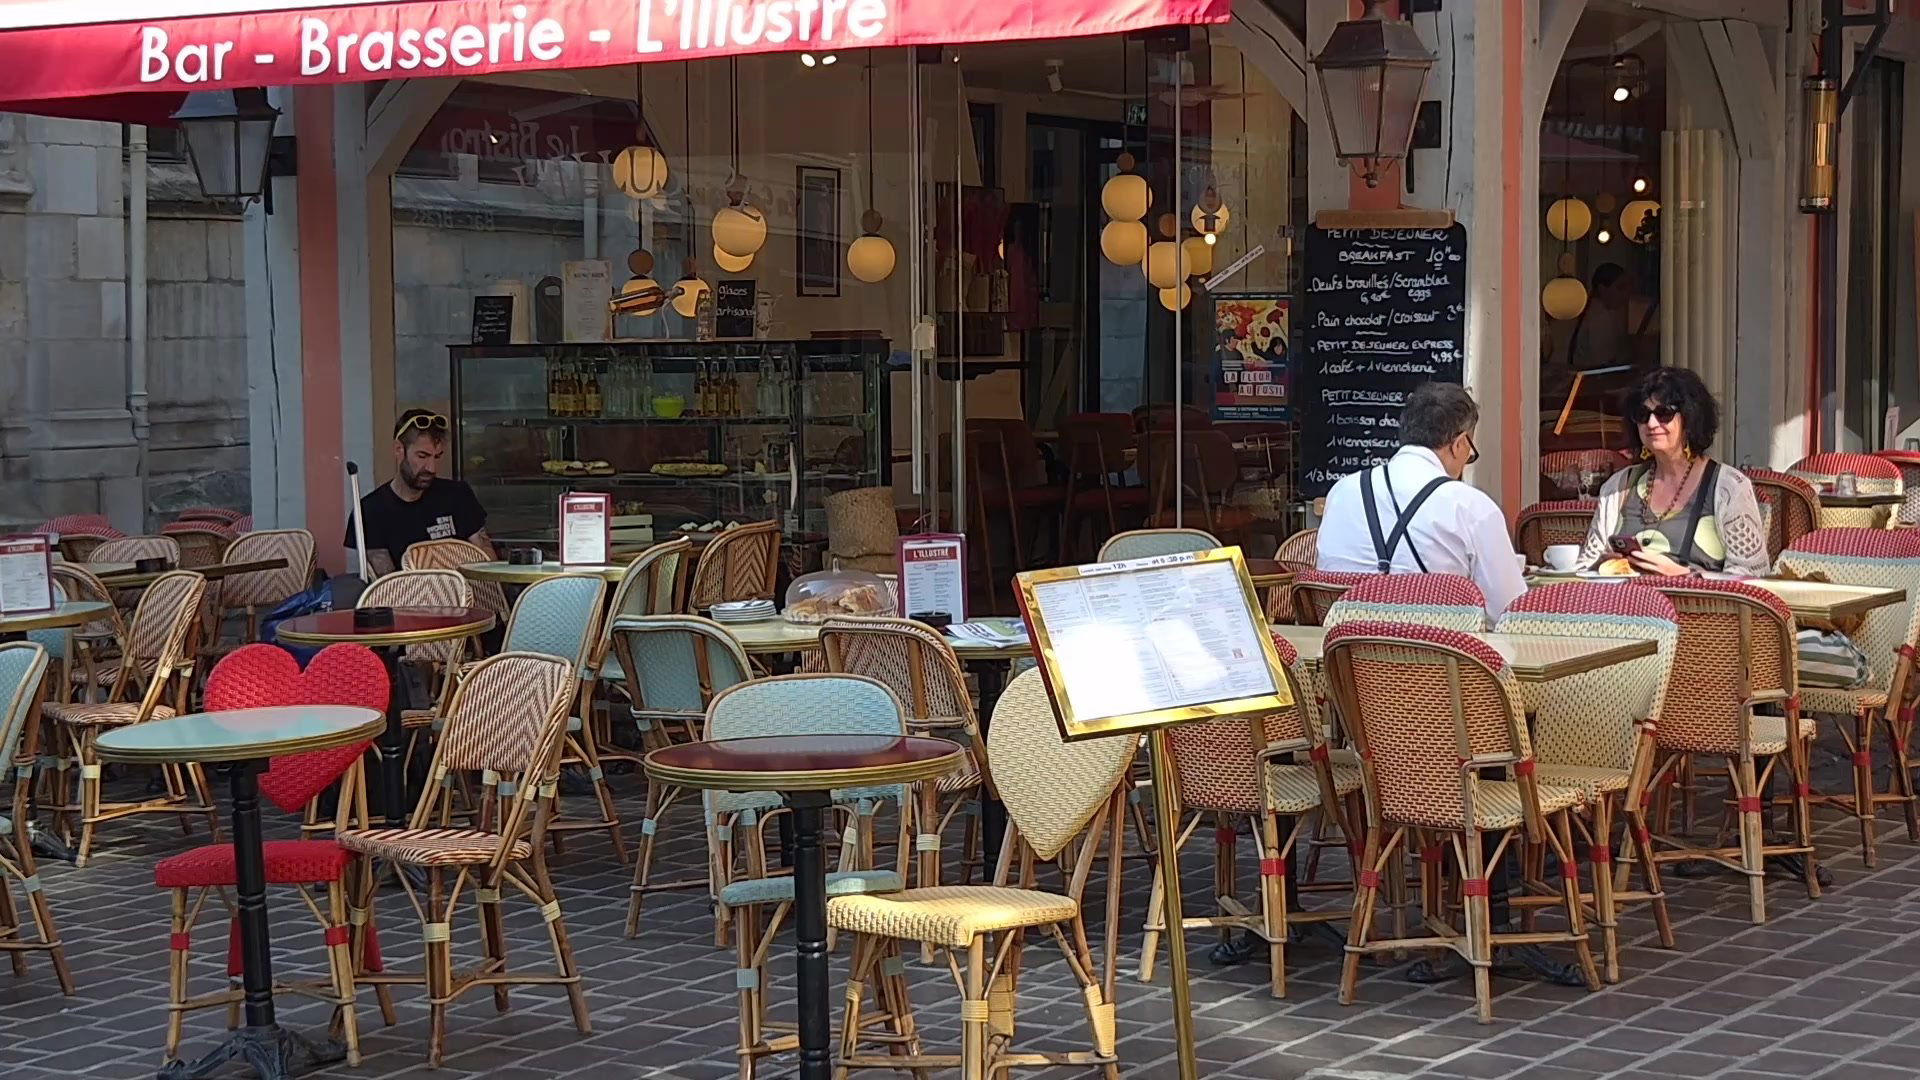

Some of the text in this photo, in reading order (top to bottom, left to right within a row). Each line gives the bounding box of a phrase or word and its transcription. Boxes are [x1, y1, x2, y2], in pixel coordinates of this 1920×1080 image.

[139, 28, 234, 83] Bar
[300, 5, 566, 77] Brasserie
[1328, 230, 1447, 240] PETIT DEJEUNER
[1339, 251, 1414, 261] BREAKFAST
[1408, 289, 1431, 302] eggs
[1318, 312, 1339, 326] Pain
[1317, 340, 1453, 350] PETIT DEJEUNER EXPRESS
[1225, 372, 1271, 382] LA FLEUR
[1239, 386, 1252, 394] AU
[1322, 389, 1350, 401] PETIT
[1353, 391, 1403, 401] DEJEUNER
[1342, 457, 1358, 466] jus
